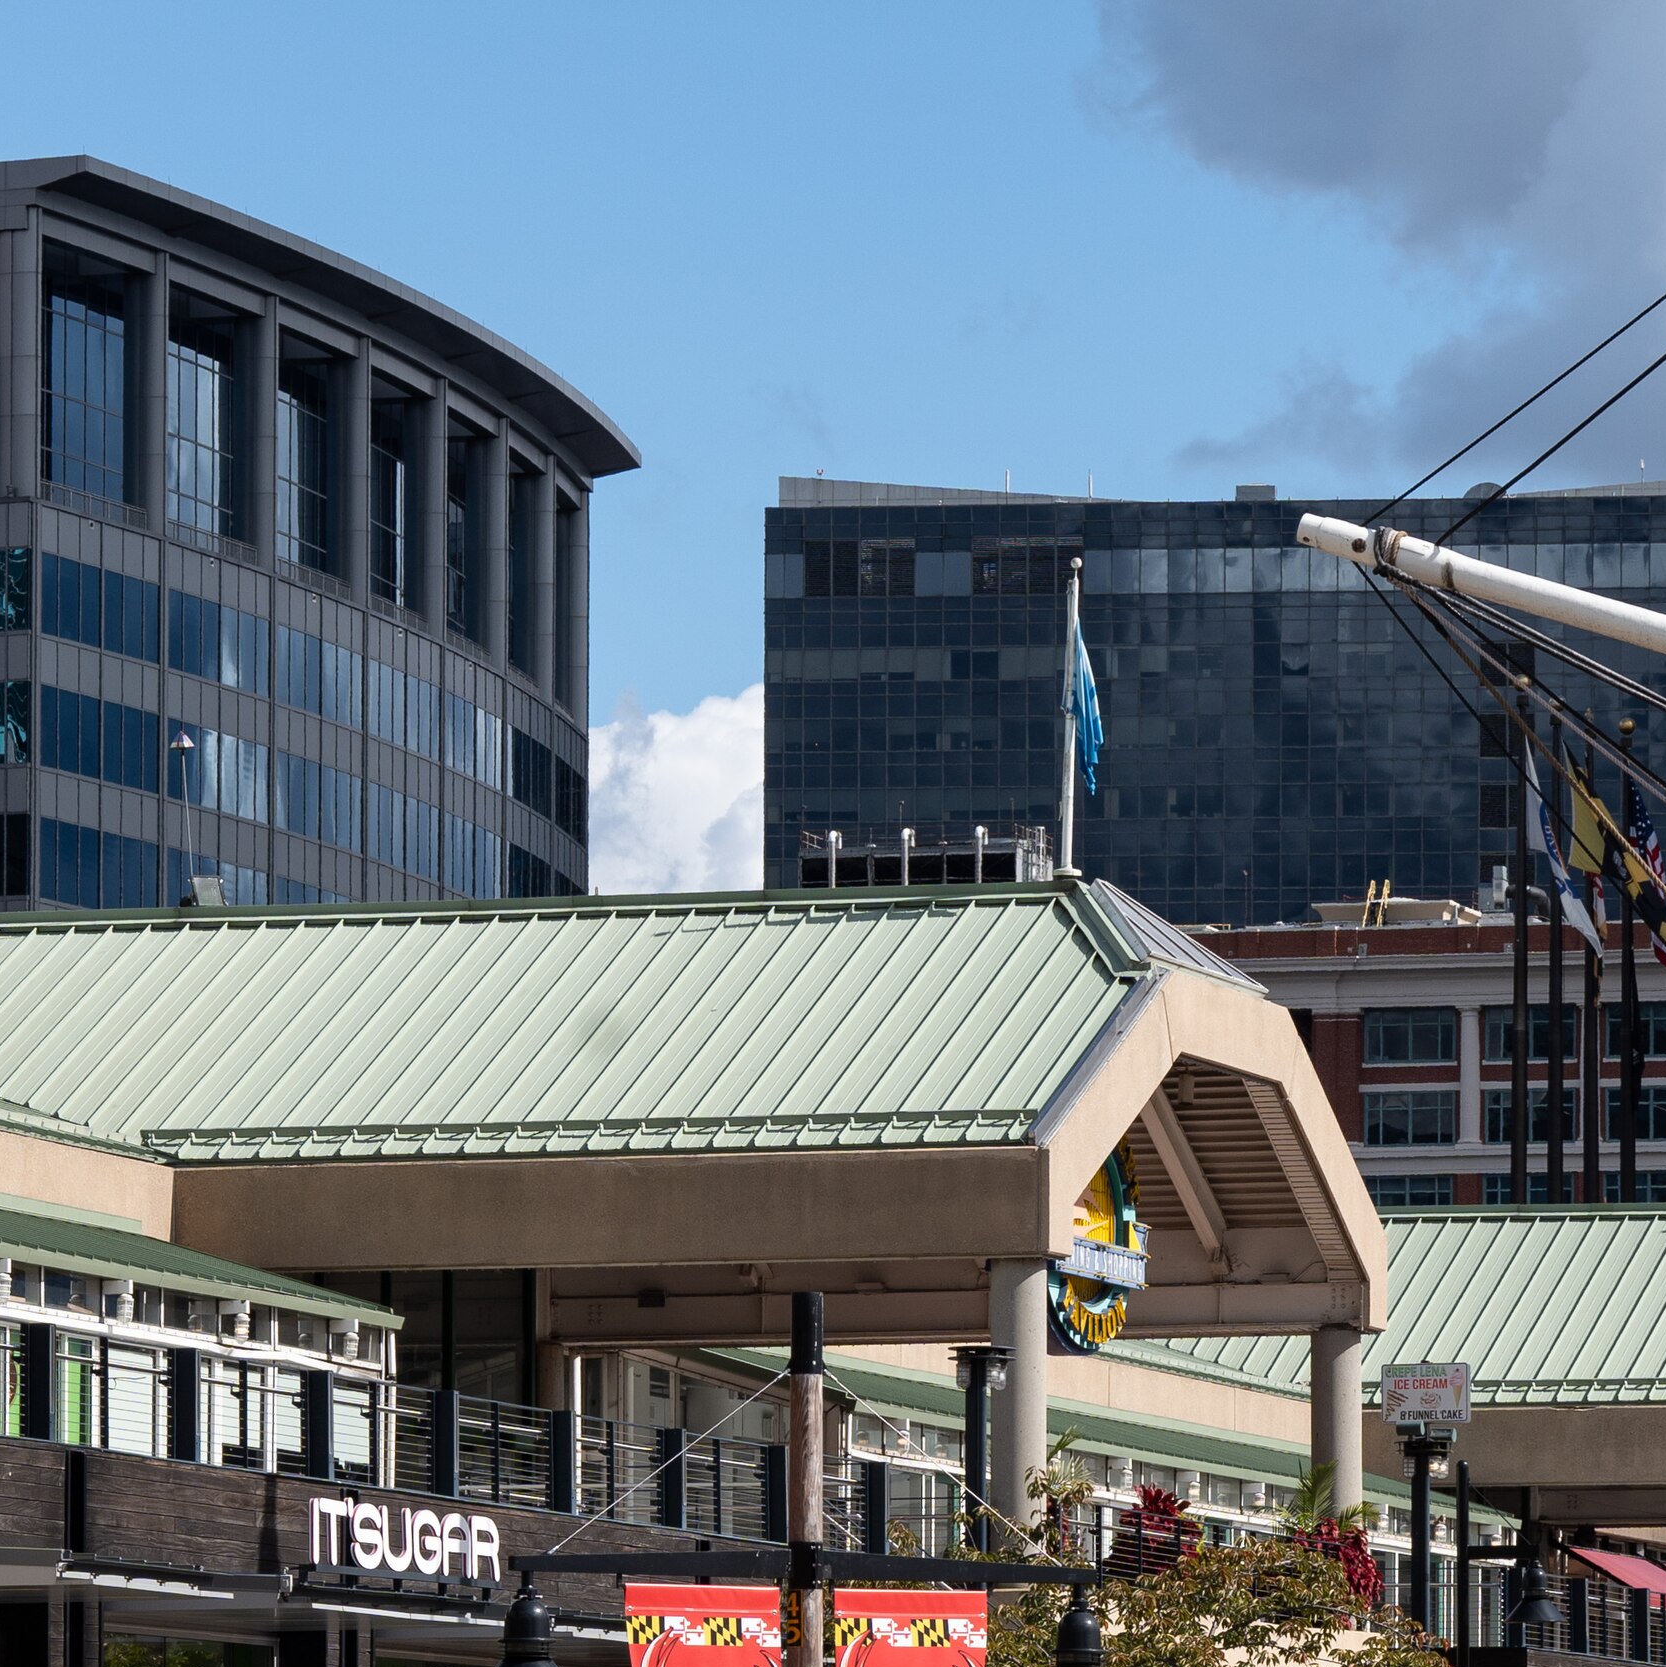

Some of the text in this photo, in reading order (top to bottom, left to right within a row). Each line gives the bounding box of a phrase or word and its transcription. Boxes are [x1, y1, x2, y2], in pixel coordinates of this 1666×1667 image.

[1385, 1366, 1447, 1378] CREPE LENA
[1394, 1379, 1448, 1390] ICE CREAM
[1408, 1410, 1440, 1420] FUNNEL
[1441, 1409, 1463, 1419] CAKE
[309, 1497, 501, 1583] IT'SUGAR
